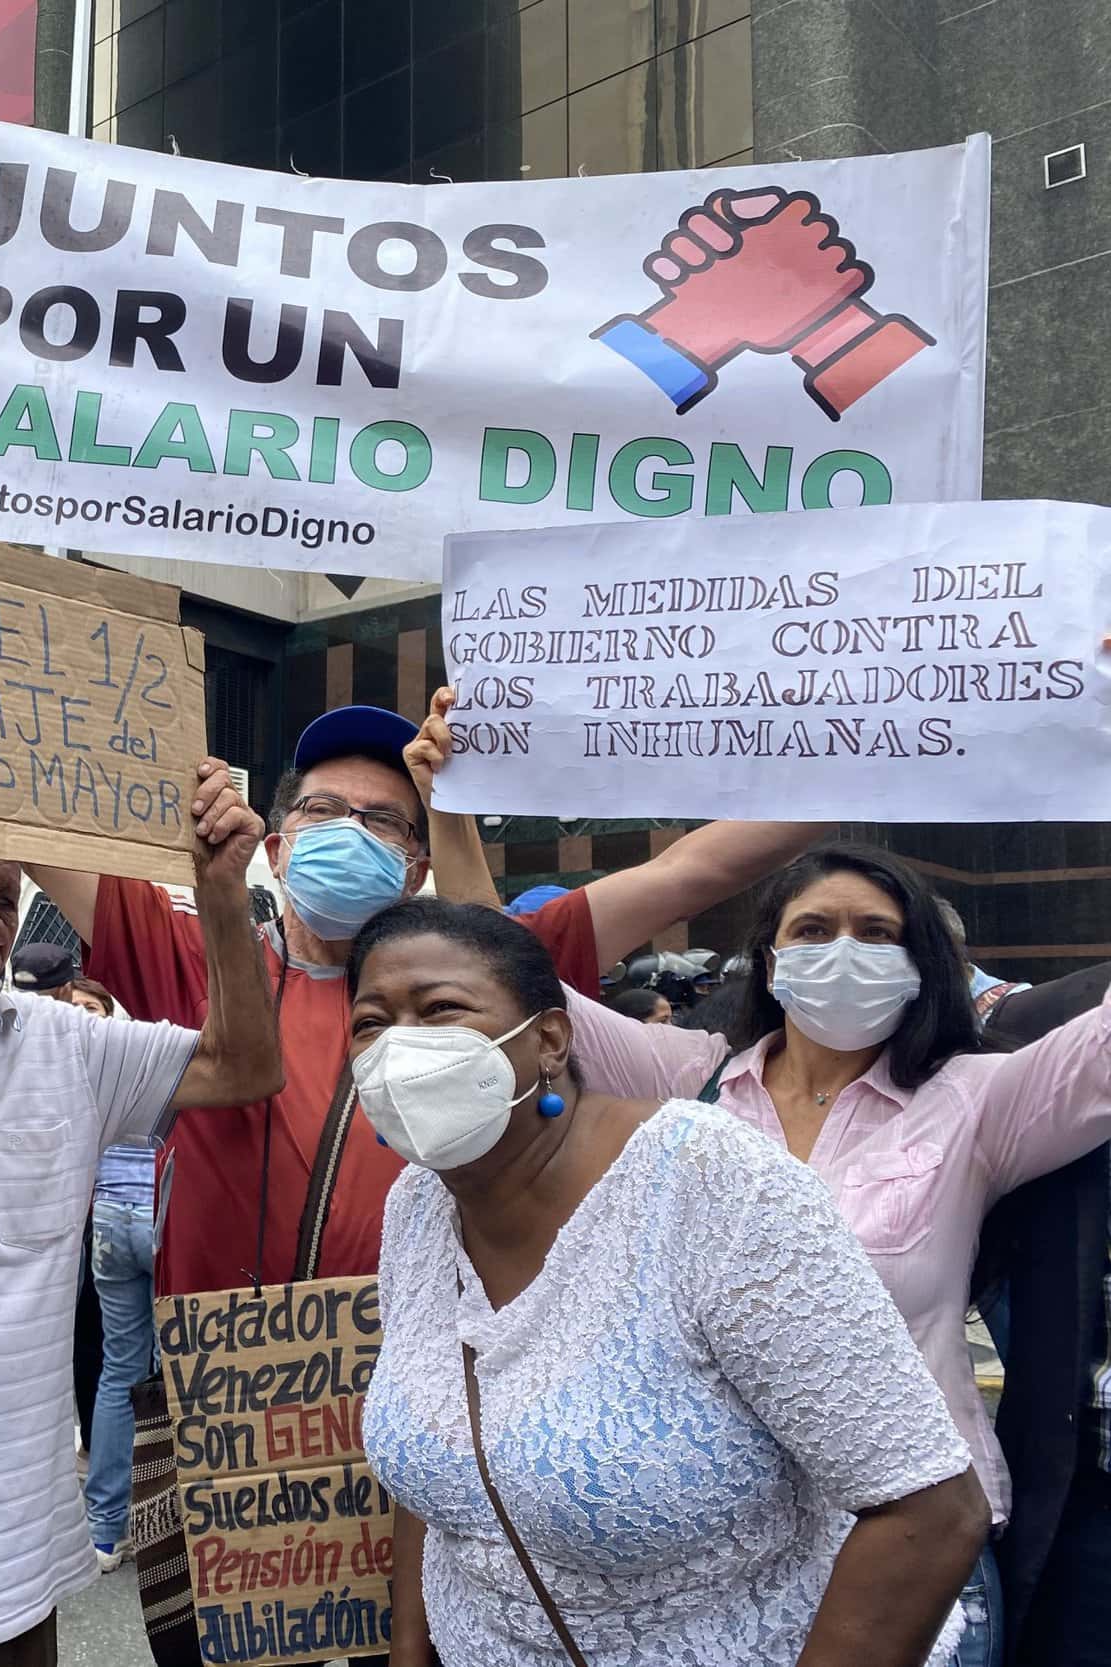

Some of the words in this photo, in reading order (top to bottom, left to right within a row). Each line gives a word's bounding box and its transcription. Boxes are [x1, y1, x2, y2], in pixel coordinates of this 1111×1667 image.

[222, 297, 404, 389] UN
[479, 427, 893, 517] DIGNO
[451, 586, 548, 622] LAS
[583, 570, 840, 618] MEDIDAS
[913, 562, 1043, 604] DEL
[449, 623, 716, 665] GOBIERNO
[771, 611, 1038, 657] CONTRA
[88, 620, 172, 725] 1/2
[450, 676, 535, 711] LOS
[587, 660, 1085, 709] TRABAJADORES
[108, 720, 157, 763] del
[447, 721, 531, 755] SON
[583, 717, 967, 758] INHUMANAS.
[30, 749, 181, 830] MAYOR
[176, 1414, 258, 1471] Son
[192, 1525, 343, 1599] Pensión
[350, 1521, 393, 1577] de
